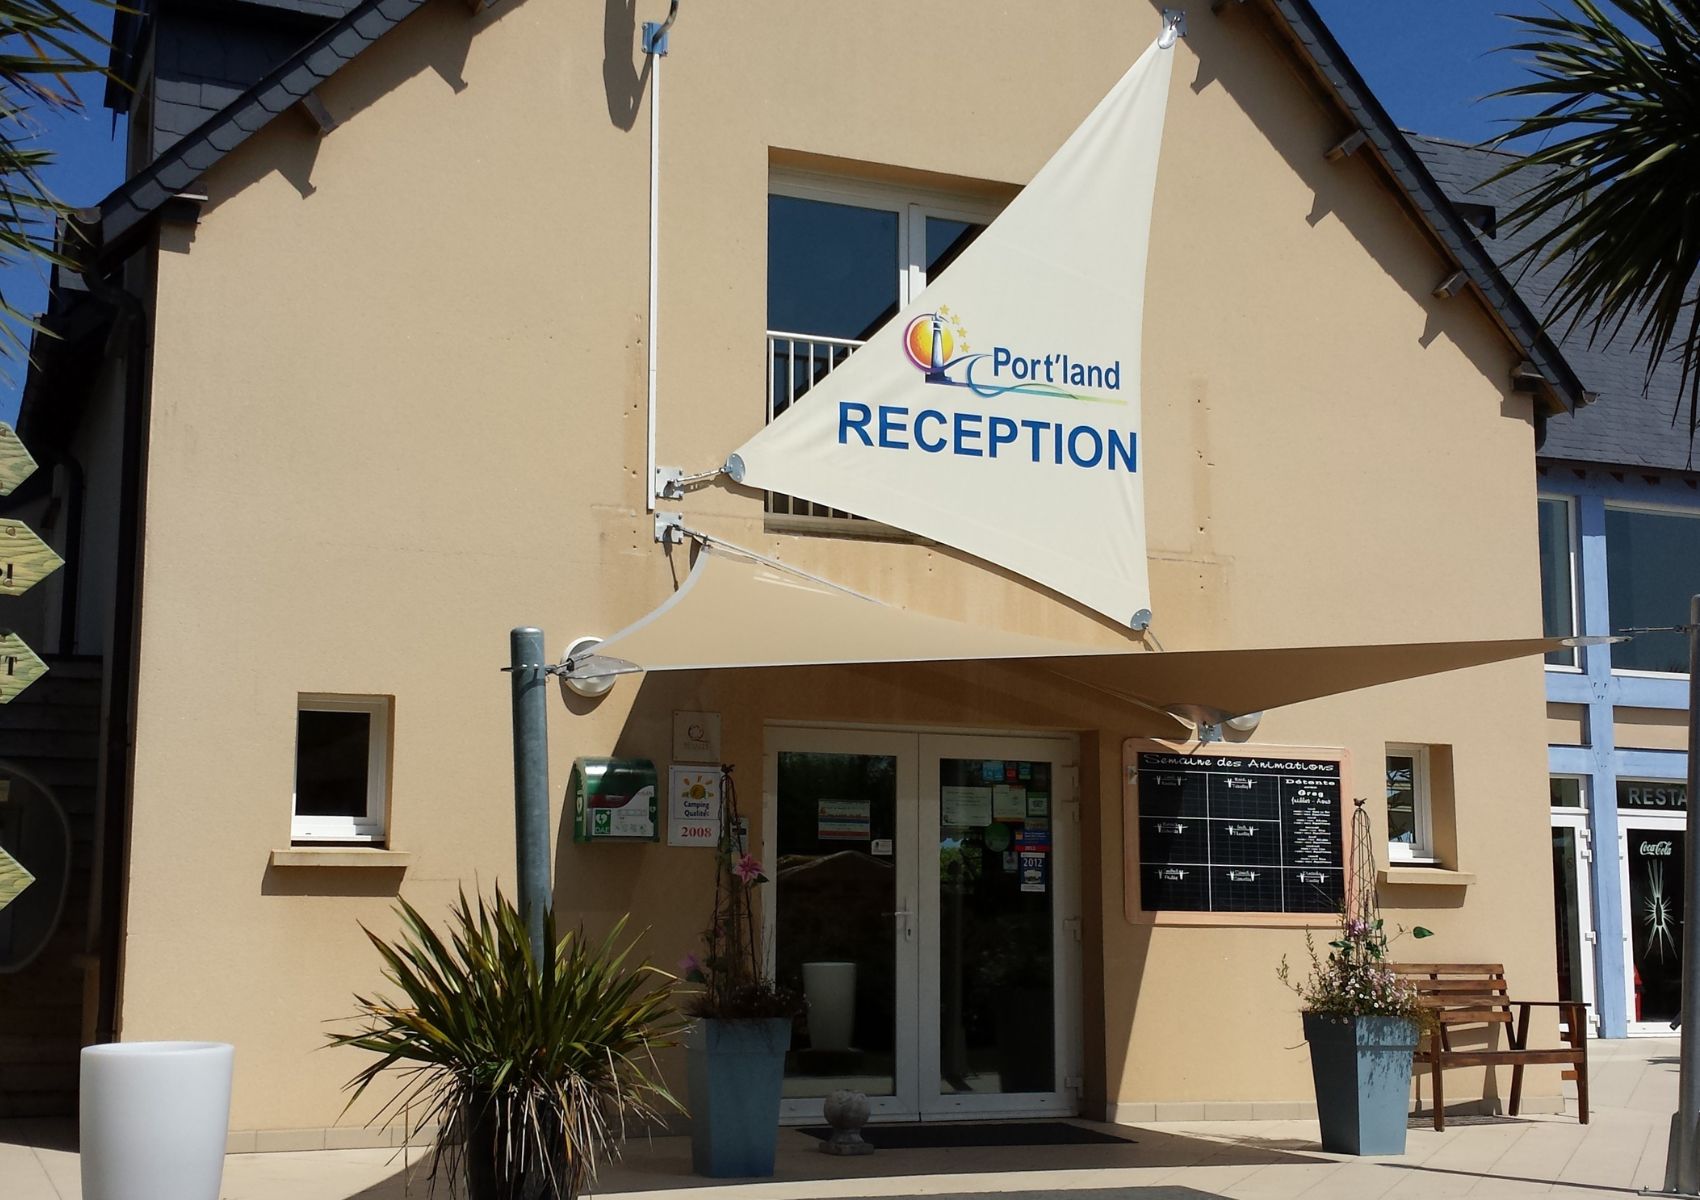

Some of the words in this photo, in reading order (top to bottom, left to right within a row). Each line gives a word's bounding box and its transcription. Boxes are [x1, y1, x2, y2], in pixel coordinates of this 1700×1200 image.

[993, 346, 1120, 390] Port'land
[838, 401, 1138, 473] RECEPTION
[1143, 753, 1212, 766] Semaine
[1217, 757, 1242, 768] des
[1248, 758, 1335, 772] Animations
[683, 800, 709, 810] Camping
[681, 826, 712, 838] 2008
[1023, 858, 1043, 867] 2012
